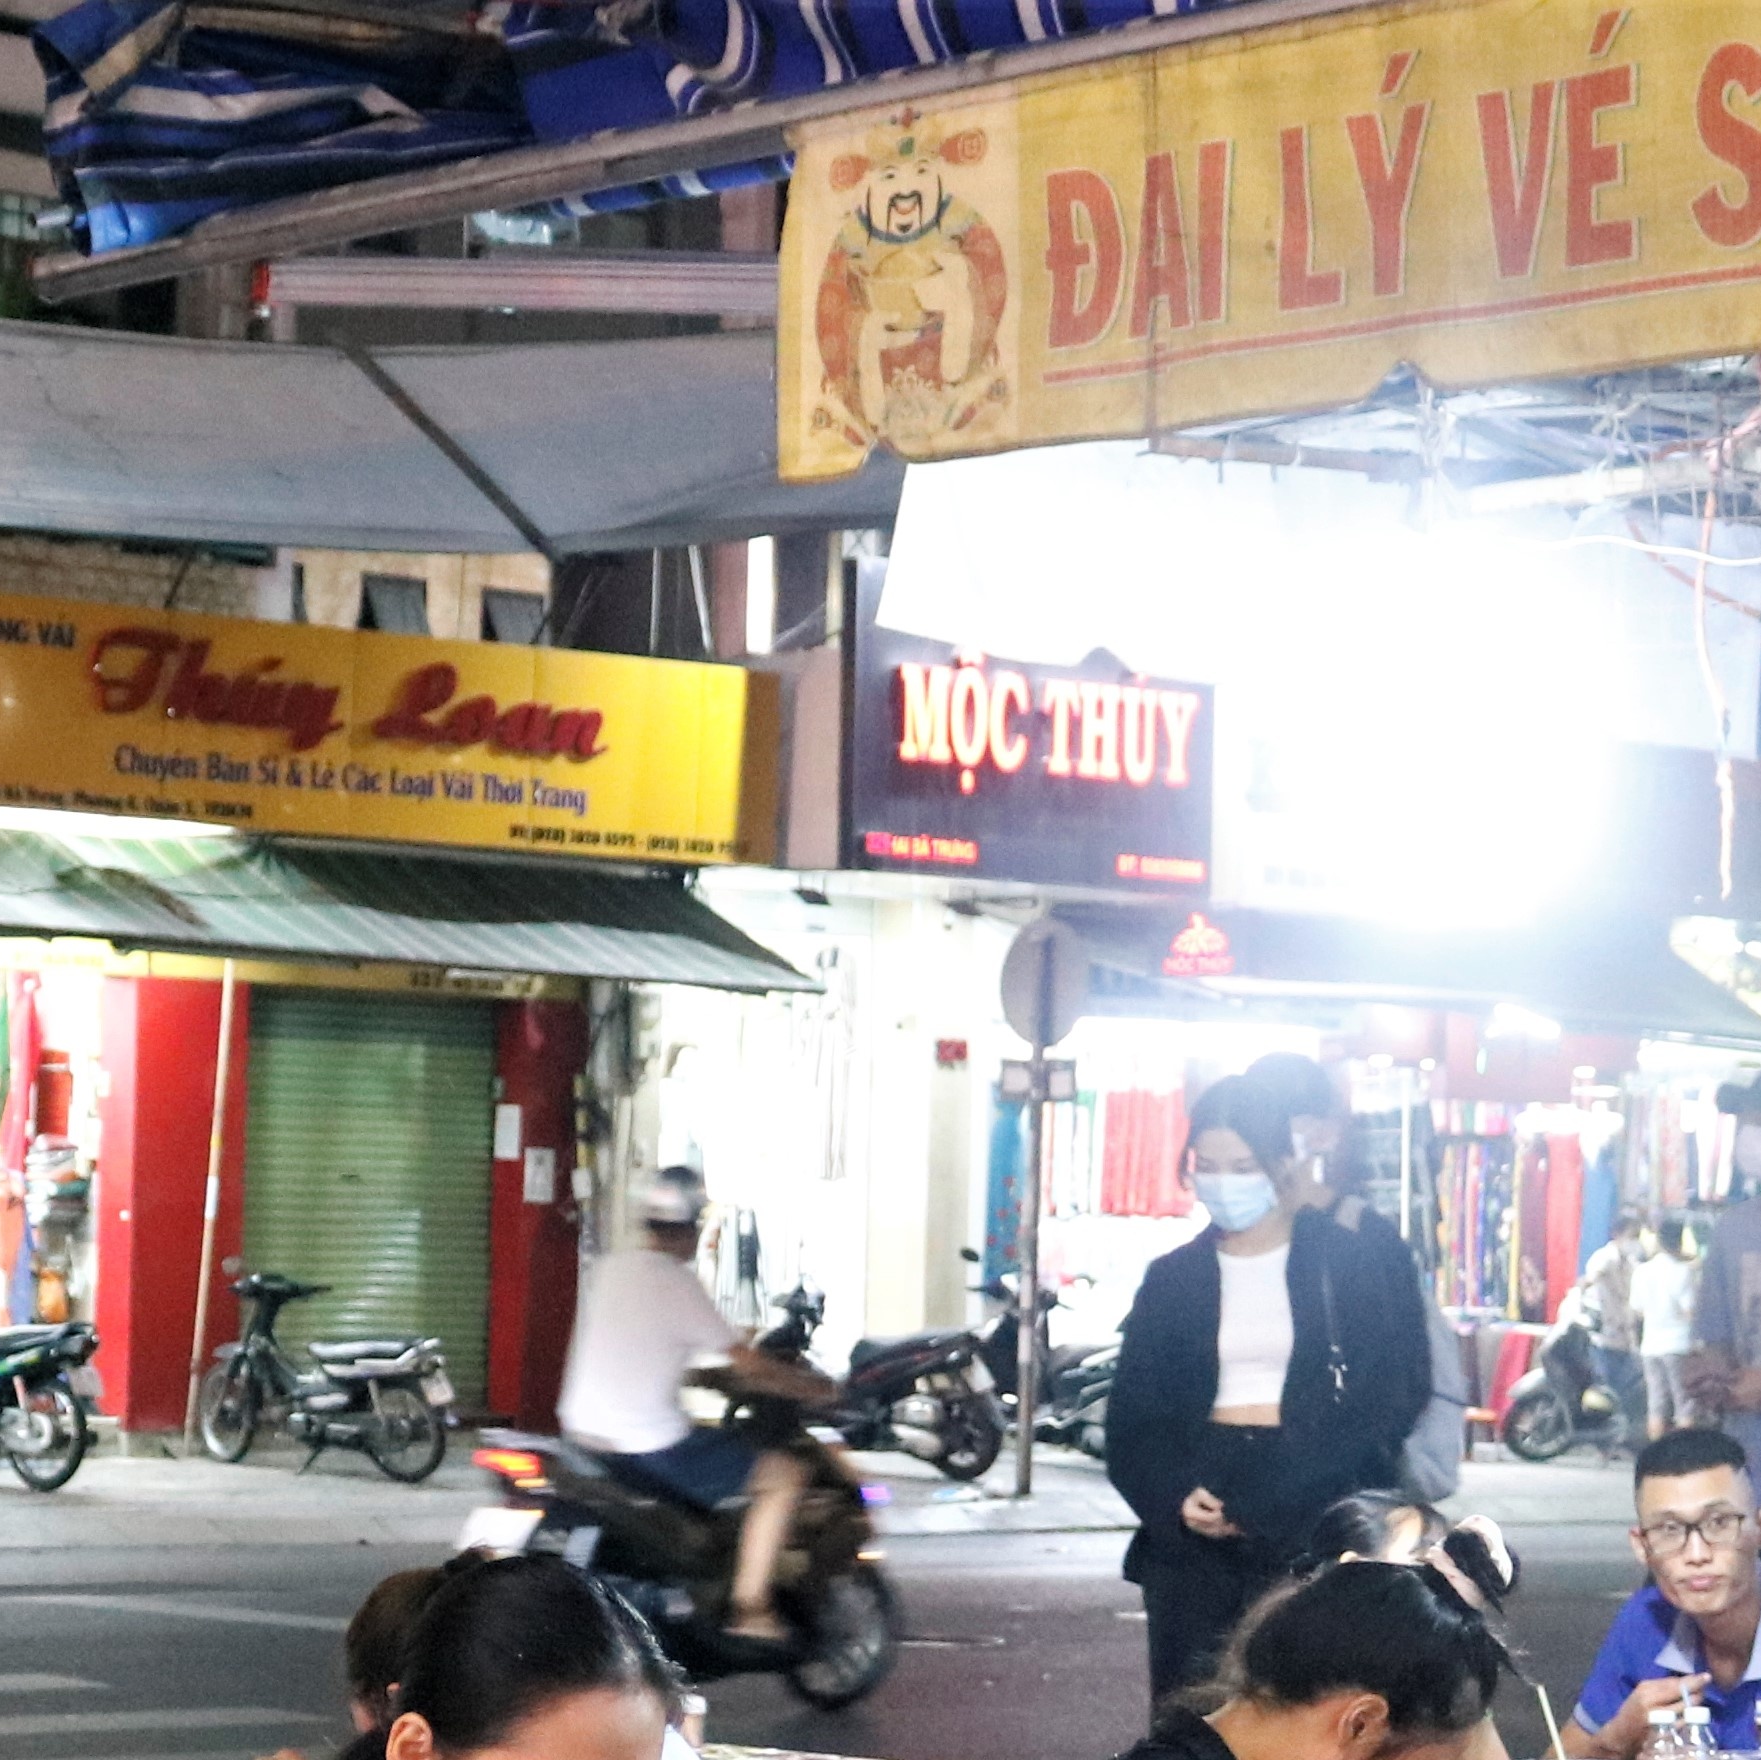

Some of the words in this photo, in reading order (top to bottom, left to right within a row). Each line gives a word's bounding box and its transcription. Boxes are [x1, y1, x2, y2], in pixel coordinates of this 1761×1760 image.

[1278, 48, 1430, 310] LÝ
[1475, 8, 1640, 280] VÉ
[372, 661, 607, 763] Loan
[531, 776, 587, 815] Trang
